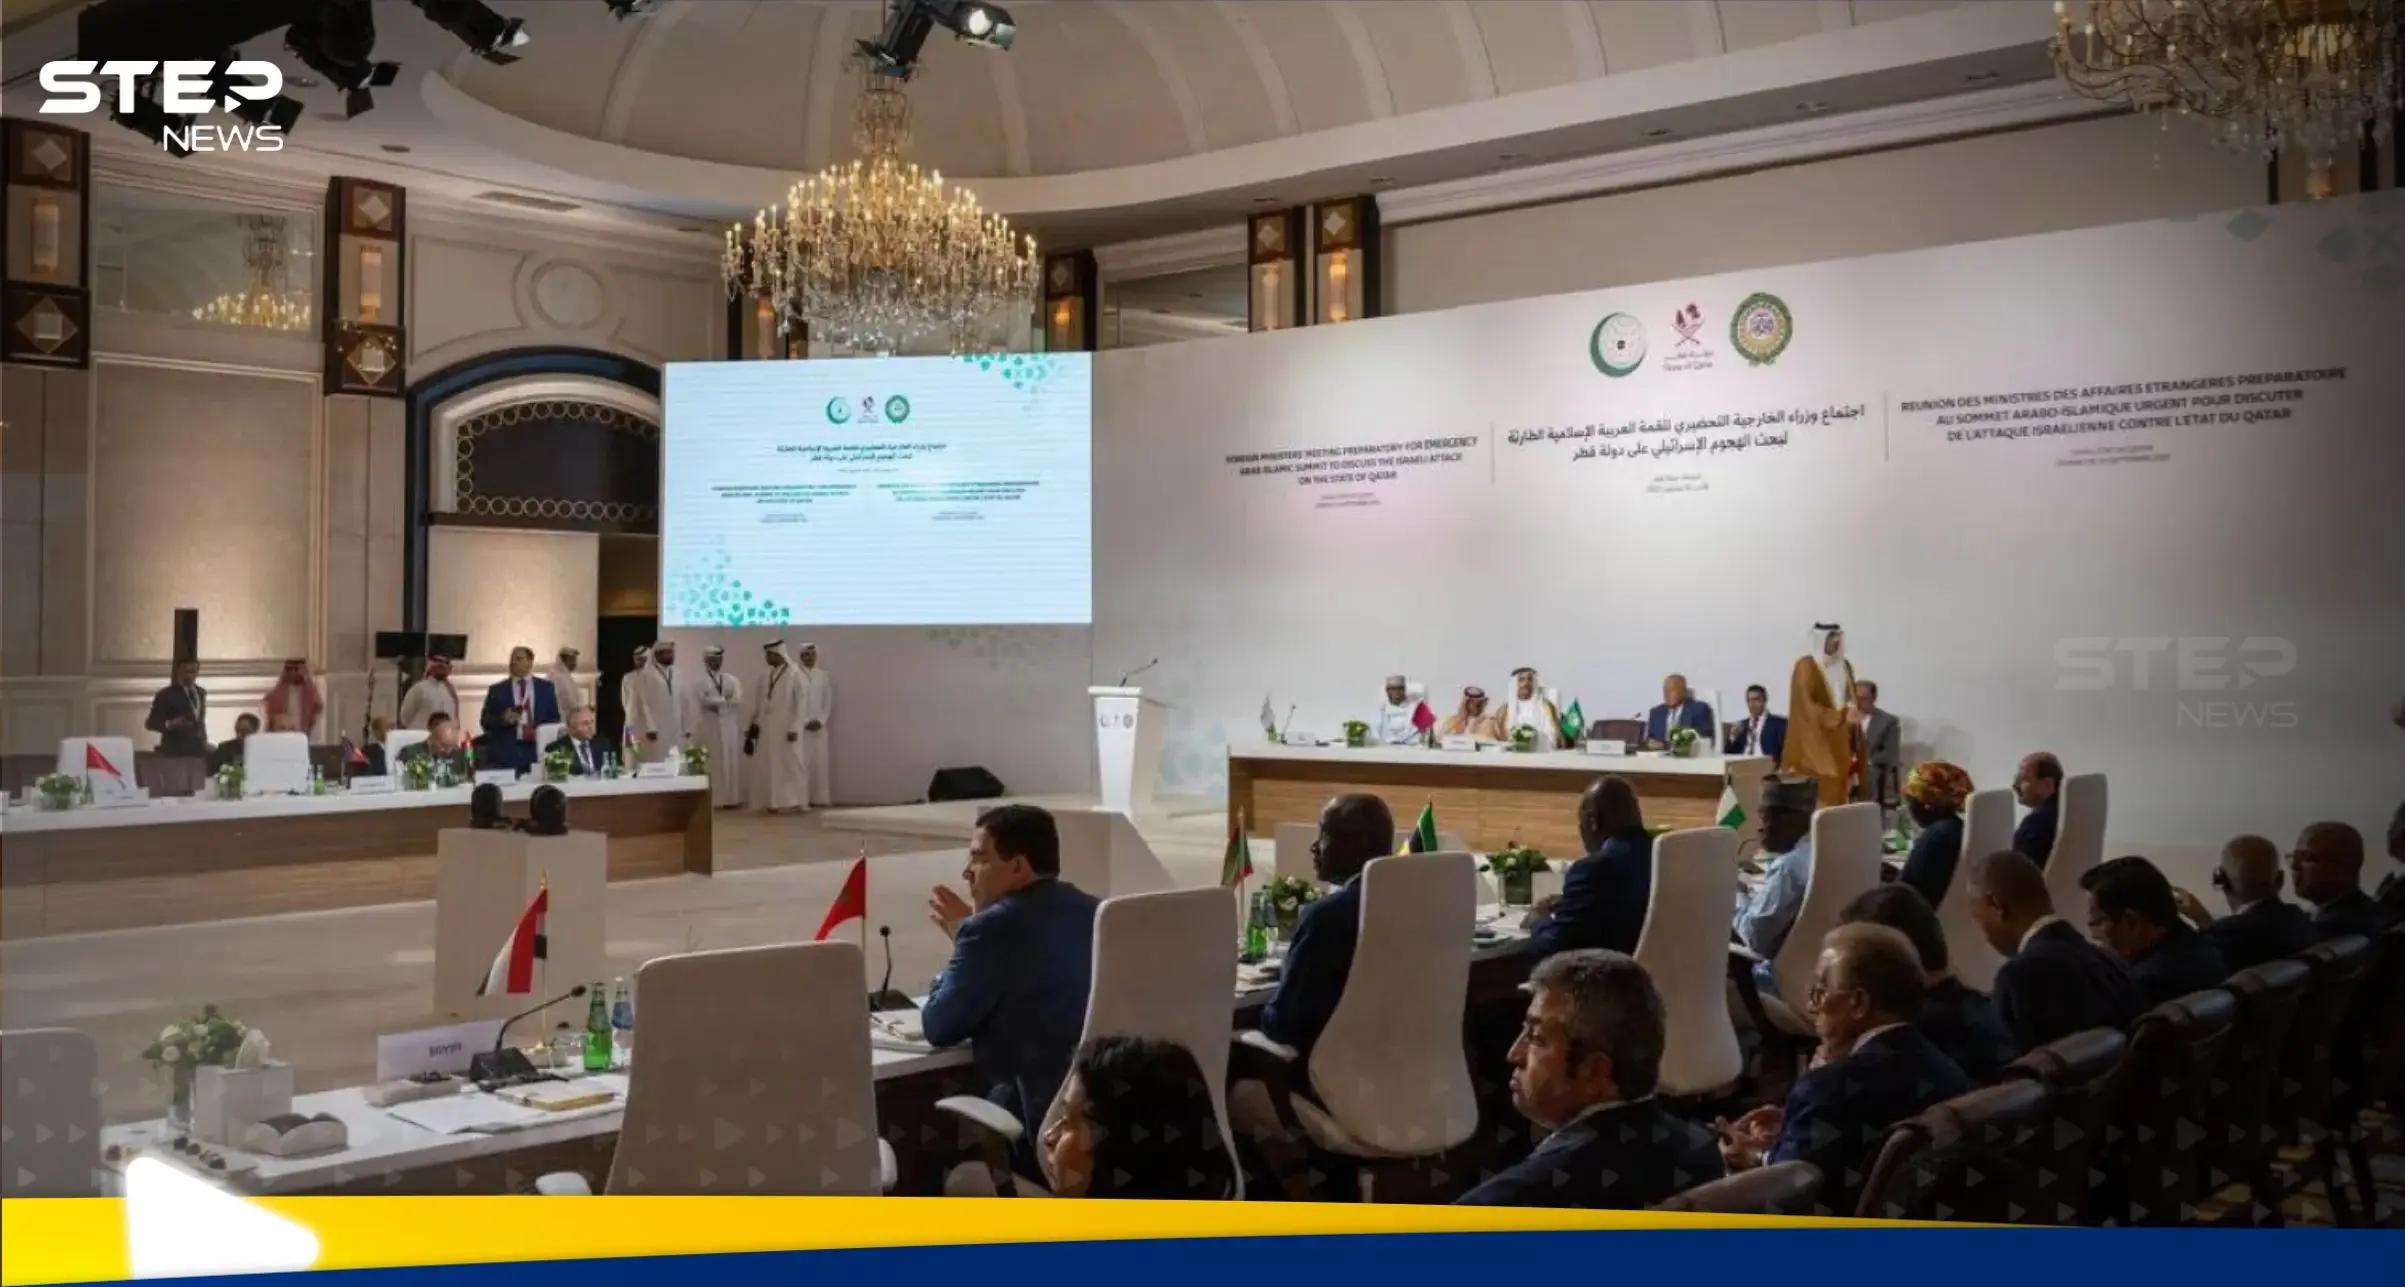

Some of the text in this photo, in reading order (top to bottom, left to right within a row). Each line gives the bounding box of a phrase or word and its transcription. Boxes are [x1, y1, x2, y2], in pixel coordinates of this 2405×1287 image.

[1957, 396, 1980, 408] DES
[1982, 391, 2050, 405] MINISTRES
[2053, 388, 2077, 400] DES
[2081, 383, 2143, 398] AFFAIRES
[1788, 408, 1818, 425] وزراء
[1822, 404, 1865, 426] اجتماع
[1936, 415, 1953, 426] AU
[1956, 410, 2009, 424] SOMMET
[2134, 397, 2186, 413] URGENT
[2192, 394, 2230, 407] POUR
[2234, 389, 2303, 405] DISCUTER
[1733, 411, 1785, 428] الخارجية
[1947, 430, 1964, 442] DE
[2119, 415, 2171, 430] CONTRE
[2219, 412, 2239, 424] DU
[2242, 408, 2291, 425] QATAR
[1598, 421, 1636, 438] العربية
[1572, 445, 1596, 462] قطر
[1600, 444, 1625, 460] دولة
[1627, 440, 1649, 459] على
[1710, 433, 1751, 455] الهجوم
